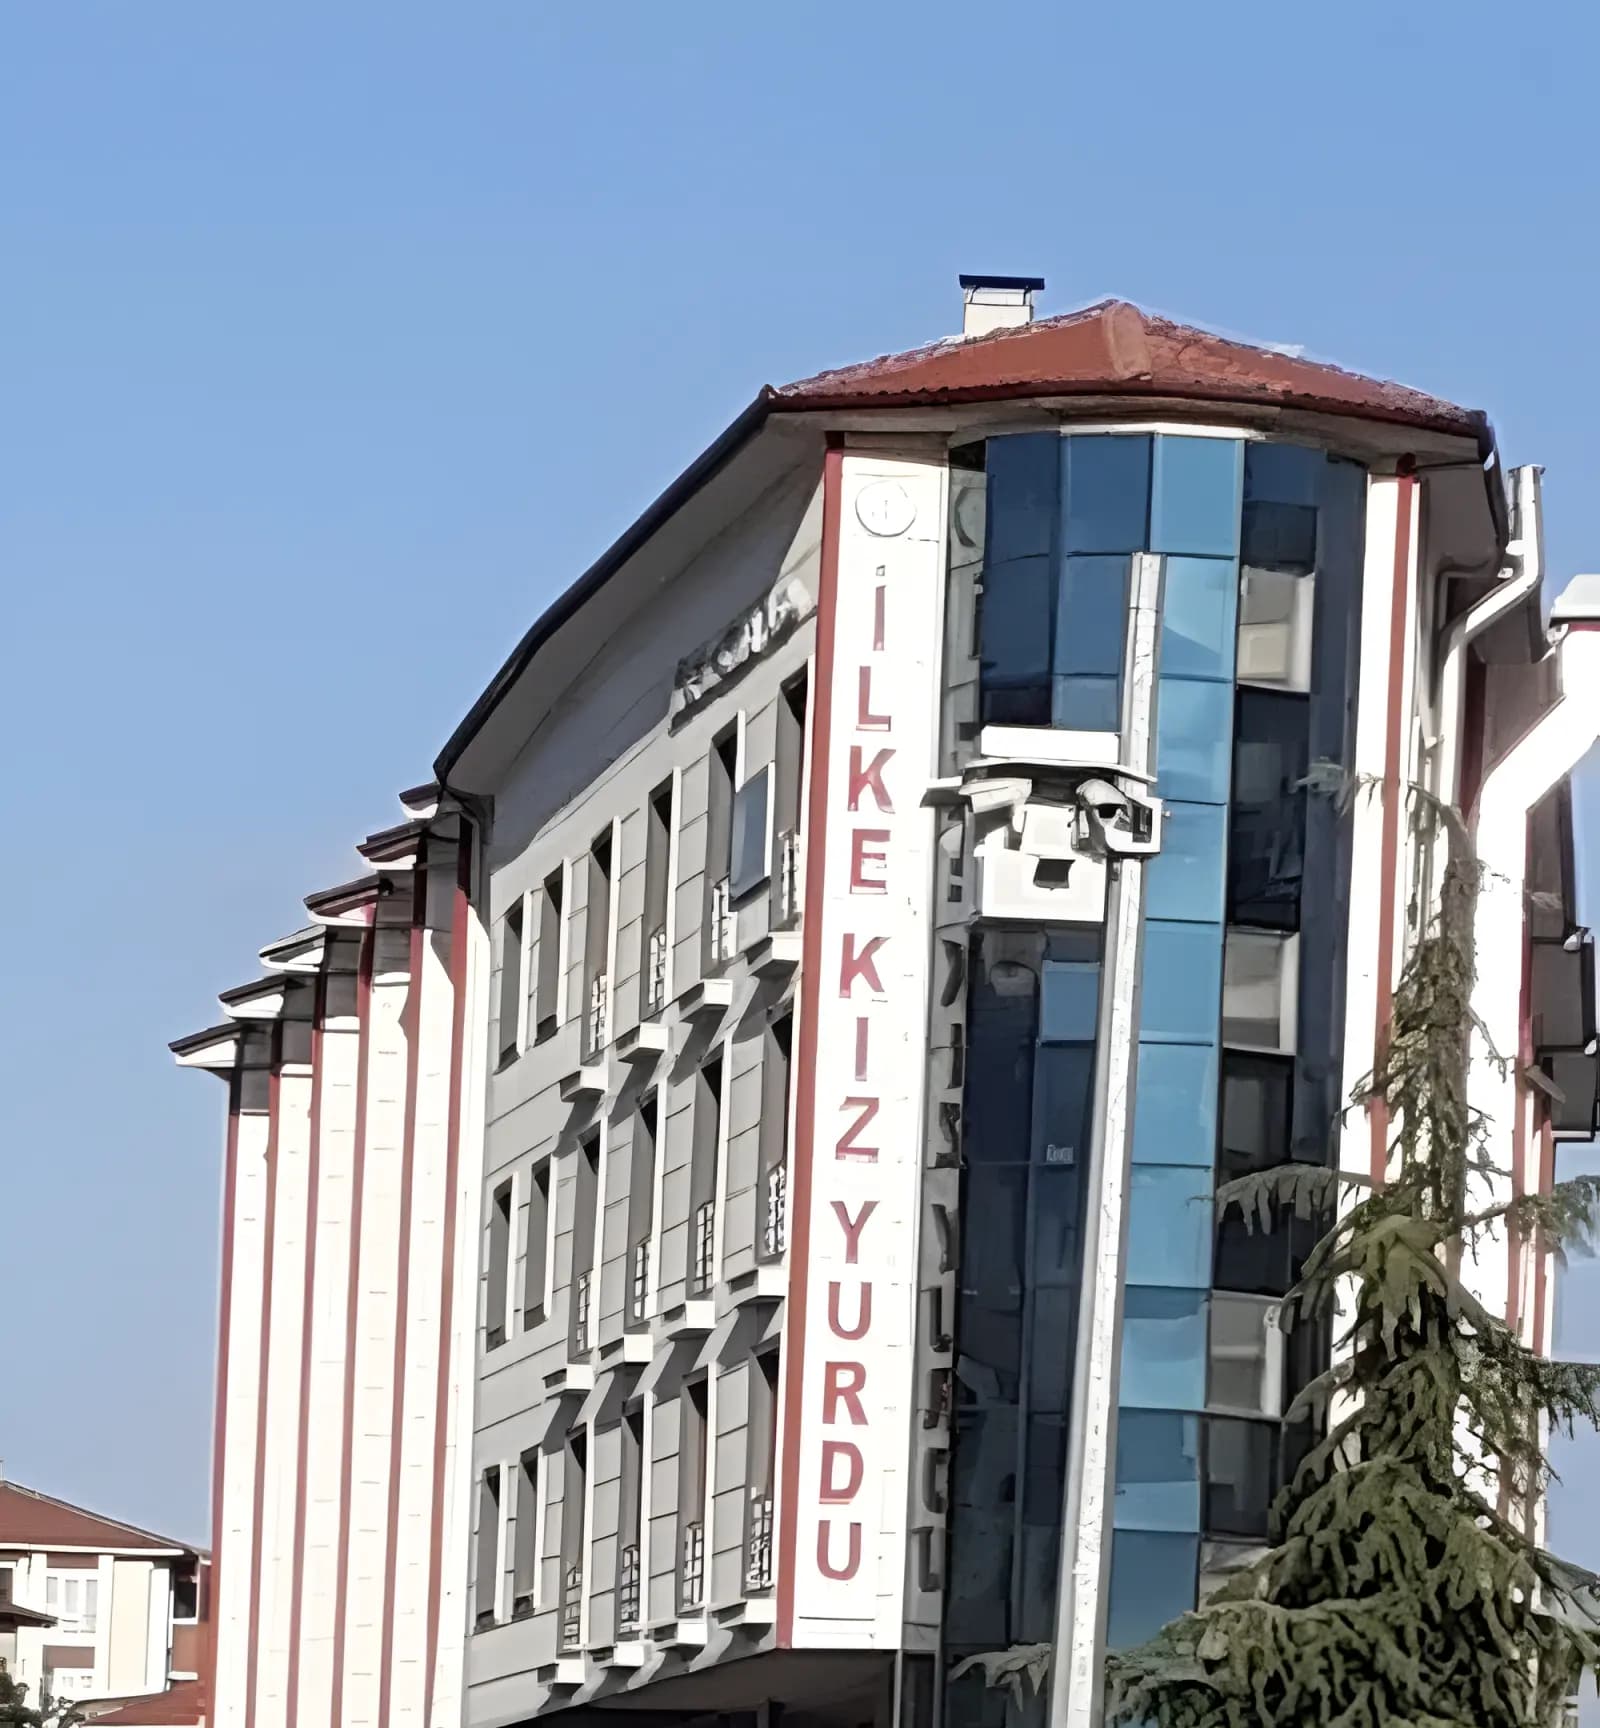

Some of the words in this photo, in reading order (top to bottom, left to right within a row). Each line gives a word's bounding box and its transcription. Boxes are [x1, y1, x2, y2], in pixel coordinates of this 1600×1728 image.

[847, 565, 896, 895] İLKE
[836, 932, 892, 1162] KIZ
[816, 1200, 880, 1581] YURDU
